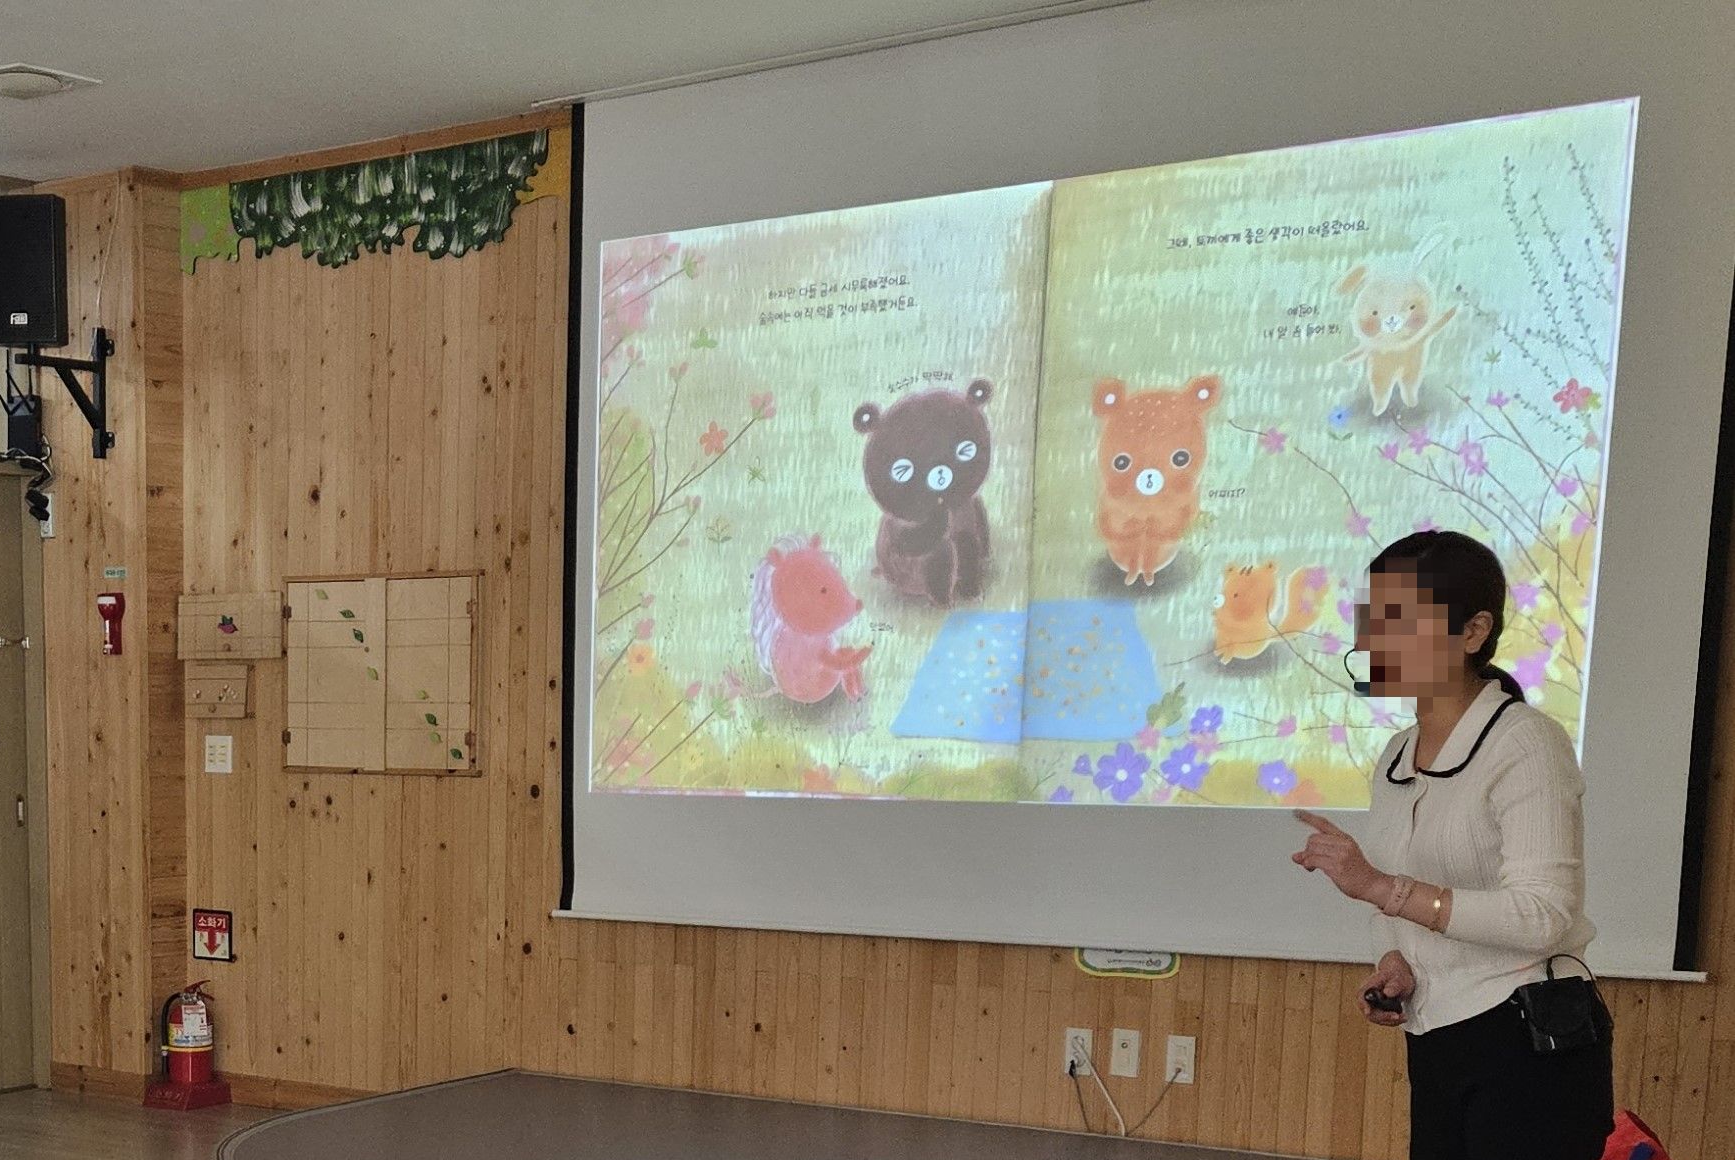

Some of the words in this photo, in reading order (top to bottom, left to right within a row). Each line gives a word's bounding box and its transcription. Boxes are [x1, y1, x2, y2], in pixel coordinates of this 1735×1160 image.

[1196, 233, 1241, 247] 토끼에게
[1244, 228, 1264, 245] 좋은
[1268, 226, 1304, 241] 생각이
[1308, 219, 1369, 238] 떠올랐어요.
[768, 287, 795, 300] 하지만
[799, 283, 817, 299] 다들
[794, 307, 814, 319] 아직
[817, 304, 834, 319] 먹을
[837, 302, 858, 316] 것이
[198, 916, 226, 929] 소화기
